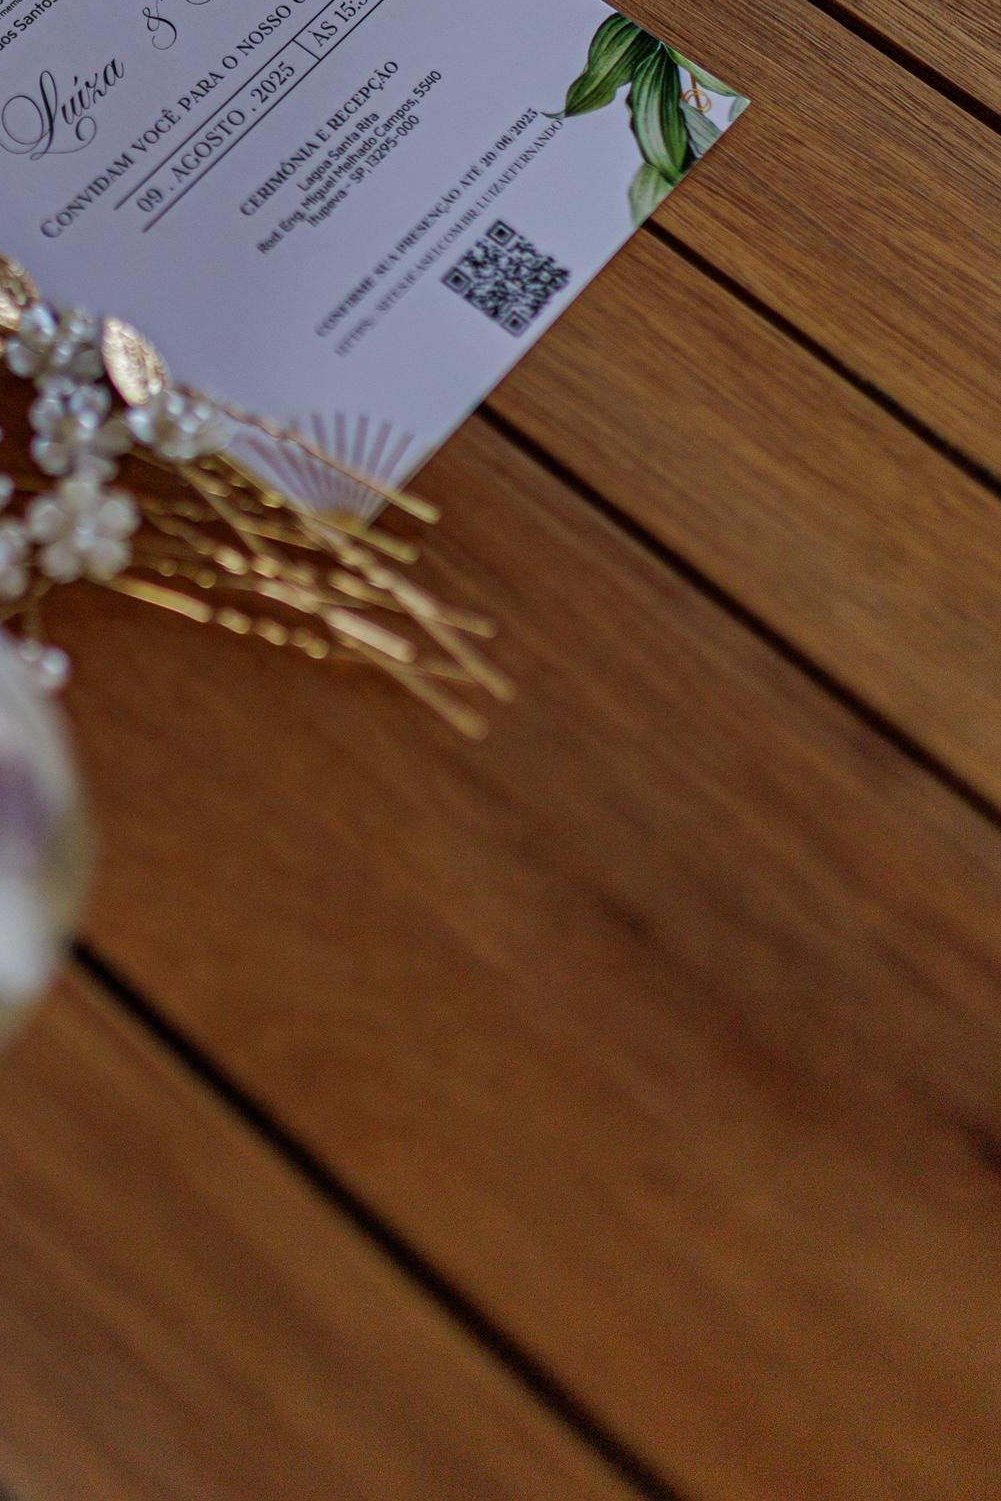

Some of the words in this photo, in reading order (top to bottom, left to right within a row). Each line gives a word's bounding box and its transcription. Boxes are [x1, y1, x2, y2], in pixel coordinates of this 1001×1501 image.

[306, 19, 338, 48] ÀS
[39, 151, 136, 238] CONVIDAM
[129, 107, 182, 152] VOCÊ
[175, 70, 225, 112] PARA
[220, 54, 239, 70] O
[234, 4, 292, 56] NOSSO
[135, 186, 164, 213] 09
[169, 108, 246, 183] AGOSTO
[249, 59, 295, 104] 2025
[238, 141, 321, 216] CERIMÔNIA
[313, 127, 331, 143] E
[324, 60, 399, 131] RECEPÇÃO
[295, 158, 334, 192] Lagoa
[326, 130, 361, 161] Santa
[353, 111, 380, 133] Rita
[299, 173, 338, 211] Miguel
[330, 135, 378, 179] Melhado
[372, 97, 420, 144] Campos,
[411, 69, 442, 98] 5540
[303, 188, 348, 228] Itupeva
[347, 165, 373, 184] SP,
[363, 113, 420, 168] 13295-000
